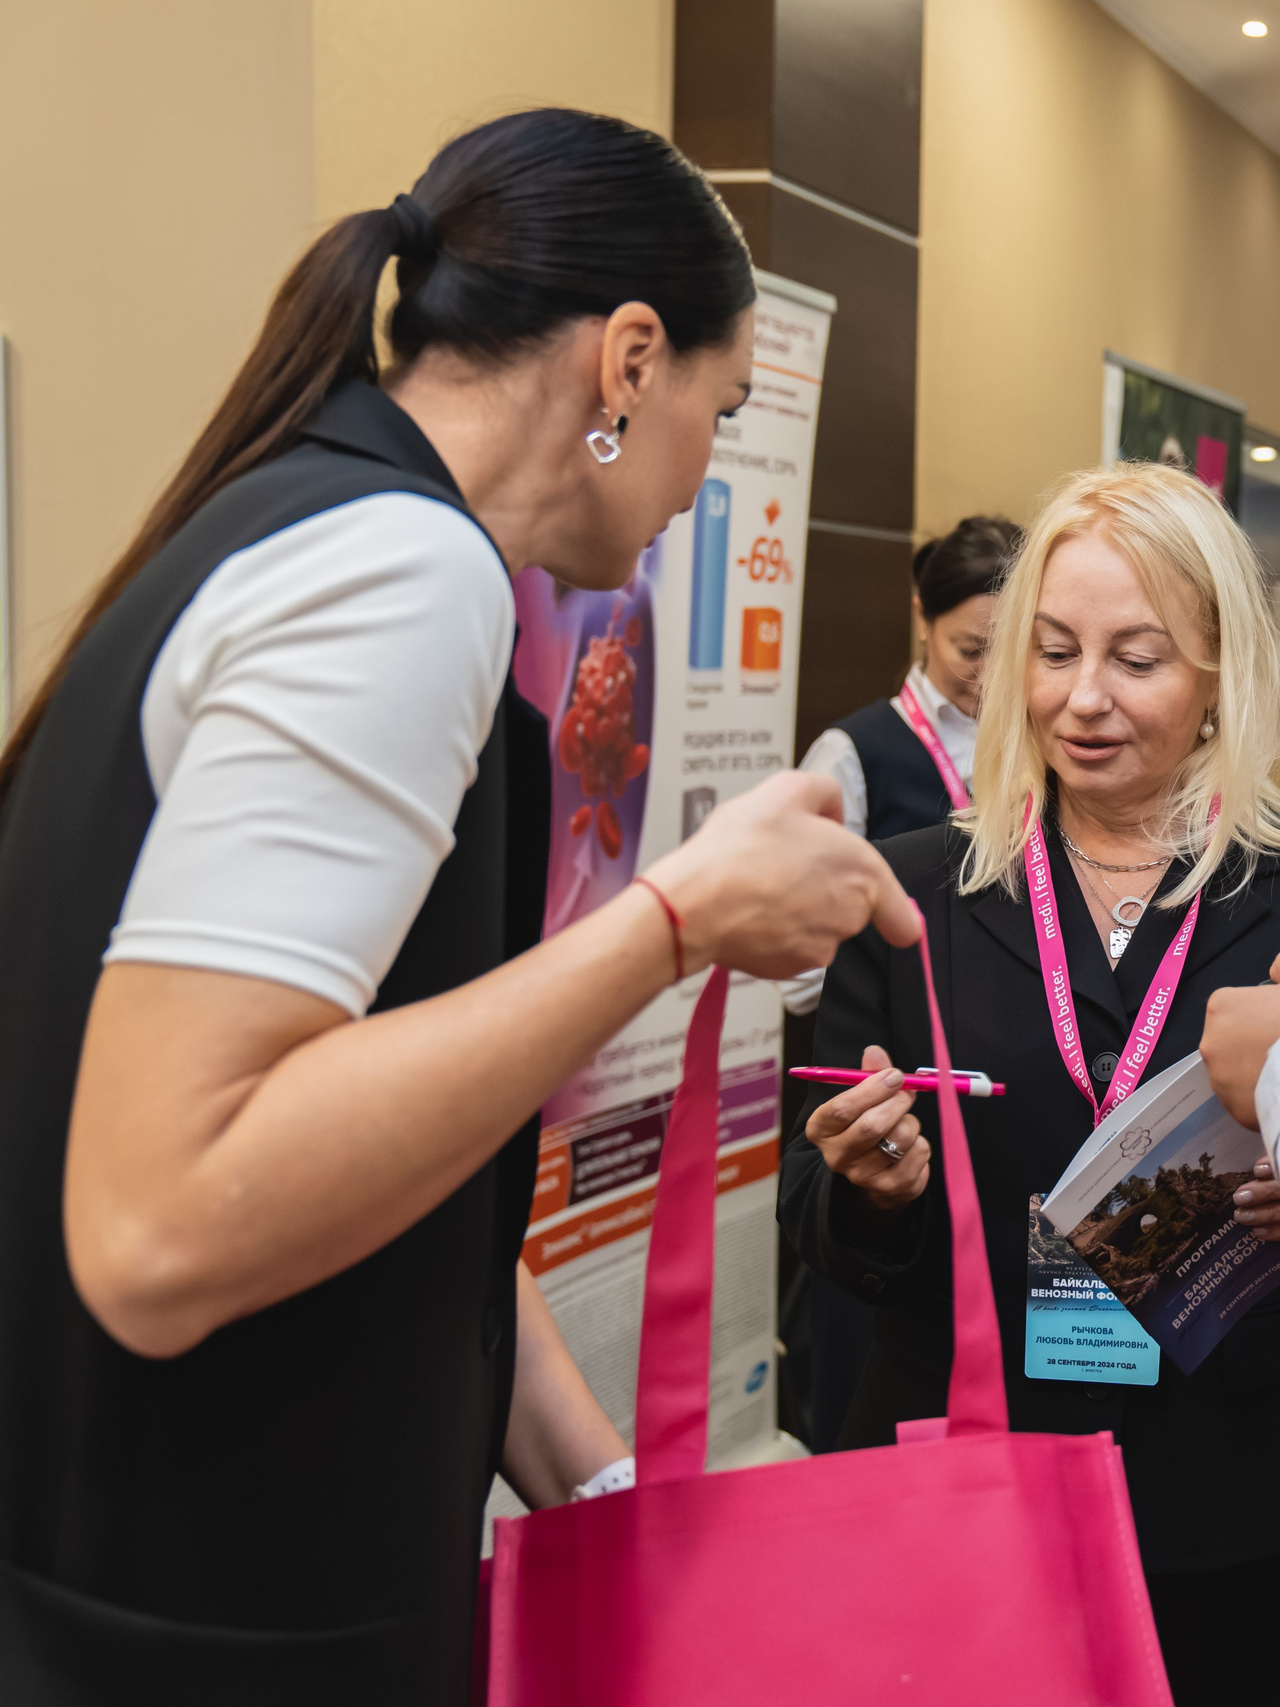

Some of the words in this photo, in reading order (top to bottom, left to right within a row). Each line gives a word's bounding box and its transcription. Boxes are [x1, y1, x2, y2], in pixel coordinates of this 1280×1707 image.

[1032, 863, 1047, 892] feel
[1037, 891, 1049, 899] I
[1038, 898, 1056, 939] medi.
[1173, 916, 1195, 955] medi.
[1052, 965, 1070, 1018] better.
[1139, 986, 1171, 1037] better.
[1059, 1017, 1076, 1050] feel
[1069, 1050, 1078, 1058] I
[1126, 1036, 1150, 1069] feel
[1123, 1069, 1135, 1078] I
[1176, 1219, 1238, 1278] ПРОГРАММ
[1031, 1288, 1094, 1300] ВЕНОЗНЫЙ
[1053, 1277, 1109, 1289] БАЙКАЛЬ
[1172, 1263, 1233, 1329] ВЕНОЗНЫЙ
[1226, 1283, 1254, 1311] СЕНТЯБРЯ
[1253, 1272, 1269, 1285] 2024
[1035, 1336, 1074, 1346] ЛЮБОВЬ
[1076, 1338, 1149, 1349] ВЛАДИМИРОВНА
[1071, 1325, 1114, 1336] РЫЧКОВА
[1057, 1359, 1096, 1367] СЕНТЯБРЯ
[1116, 1362, 1137, 1370] ГОДА
